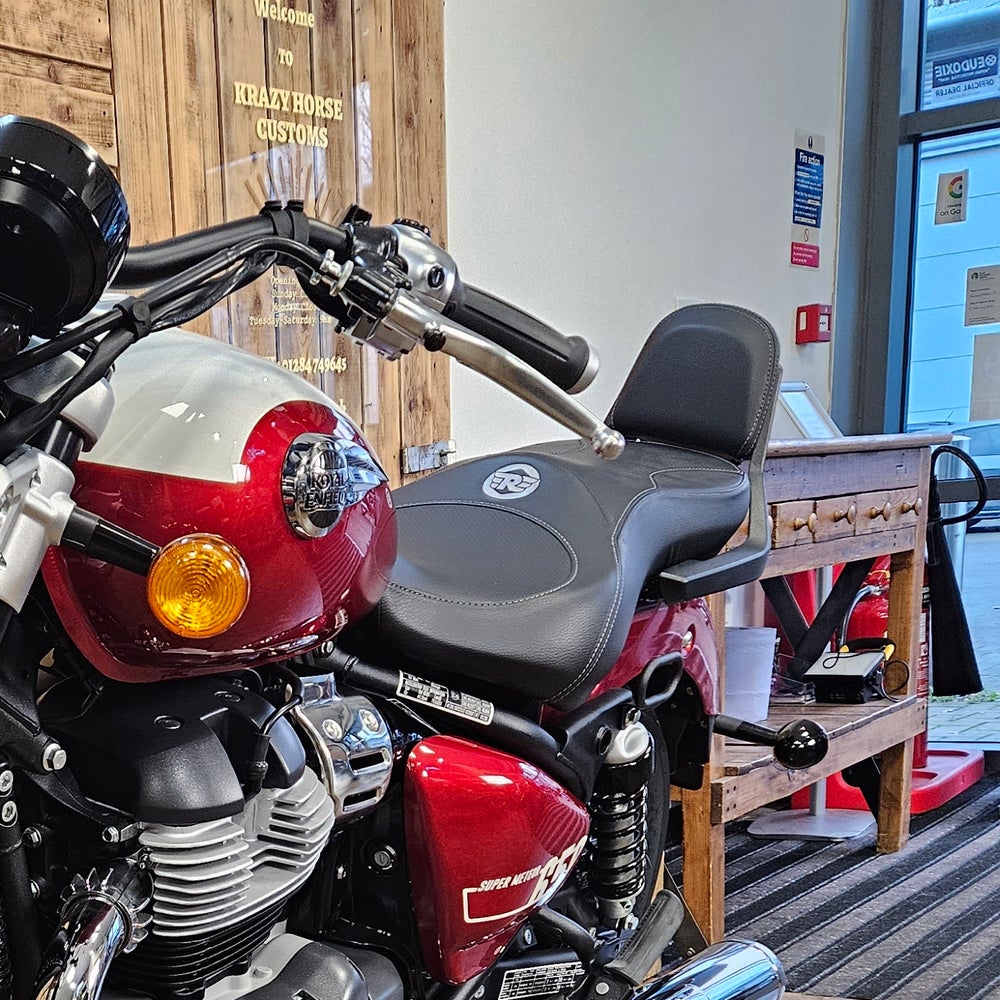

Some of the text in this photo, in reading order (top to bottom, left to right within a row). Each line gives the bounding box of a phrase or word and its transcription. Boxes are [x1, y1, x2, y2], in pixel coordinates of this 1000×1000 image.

[277, 48, 293, 66] TO
[234, 82, 343, 121] KRAZY HORSE
[256, 118, 328, 149] CUSTOMS
[478, 876, 512, 892] SUPER
